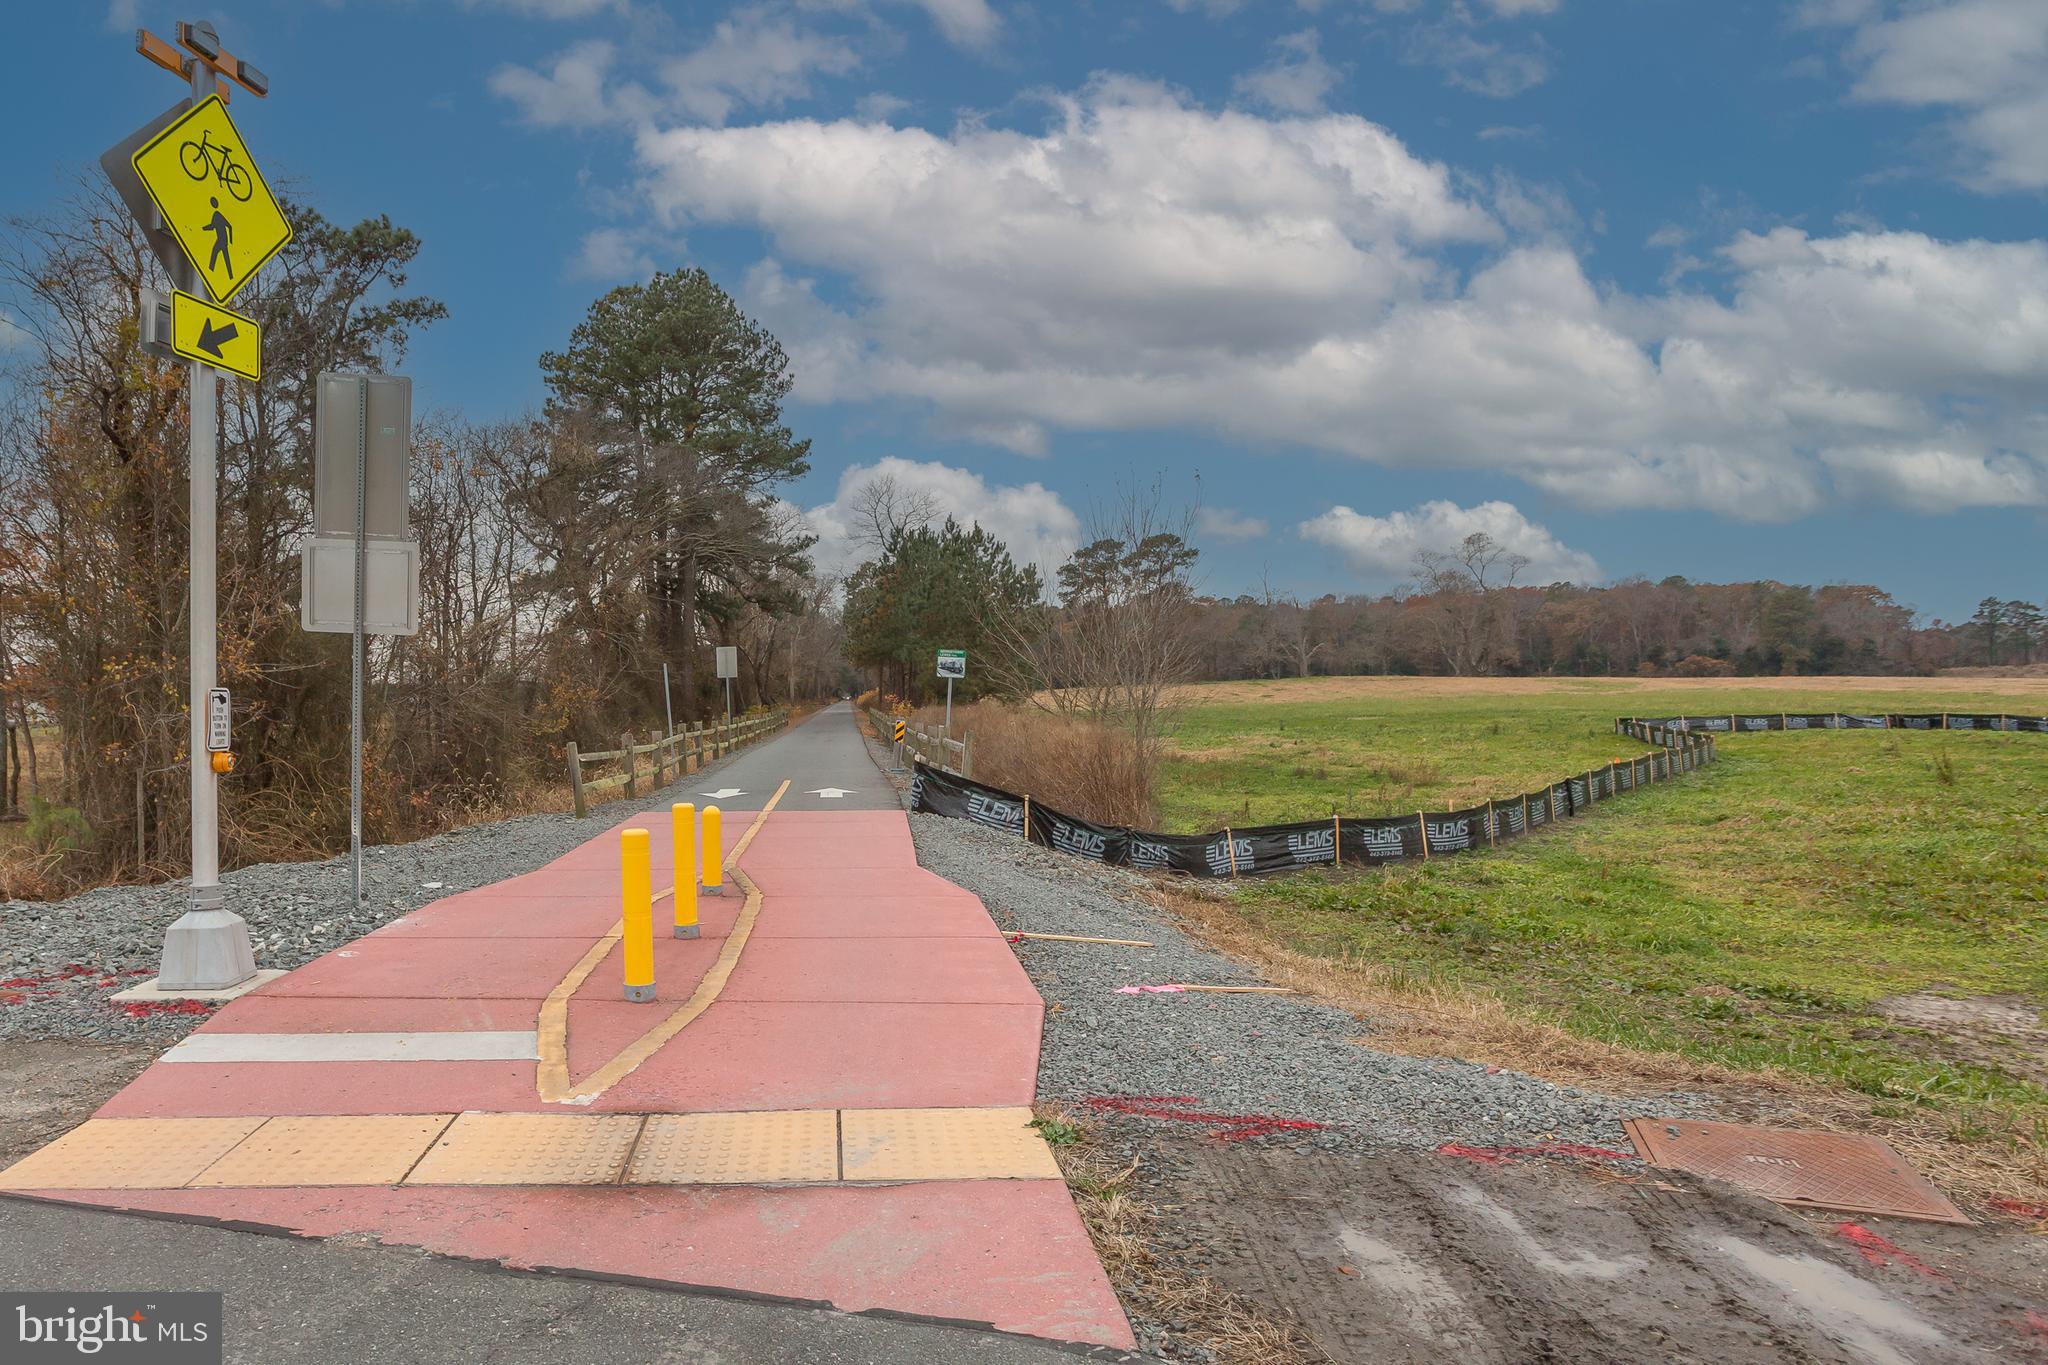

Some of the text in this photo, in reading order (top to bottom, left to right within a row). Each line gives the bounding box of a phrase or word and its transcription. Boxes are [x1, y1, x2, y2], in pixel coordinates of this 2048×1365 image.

[1061, 825, 1106, 853] LEMS
[1297, 828, 1336, 850] LEMS
[1371, 827, 1402, 844] LEMS
[1435, 820, 1469, 839] LEMS
[1215, 839, 1254, 861] LEMS
